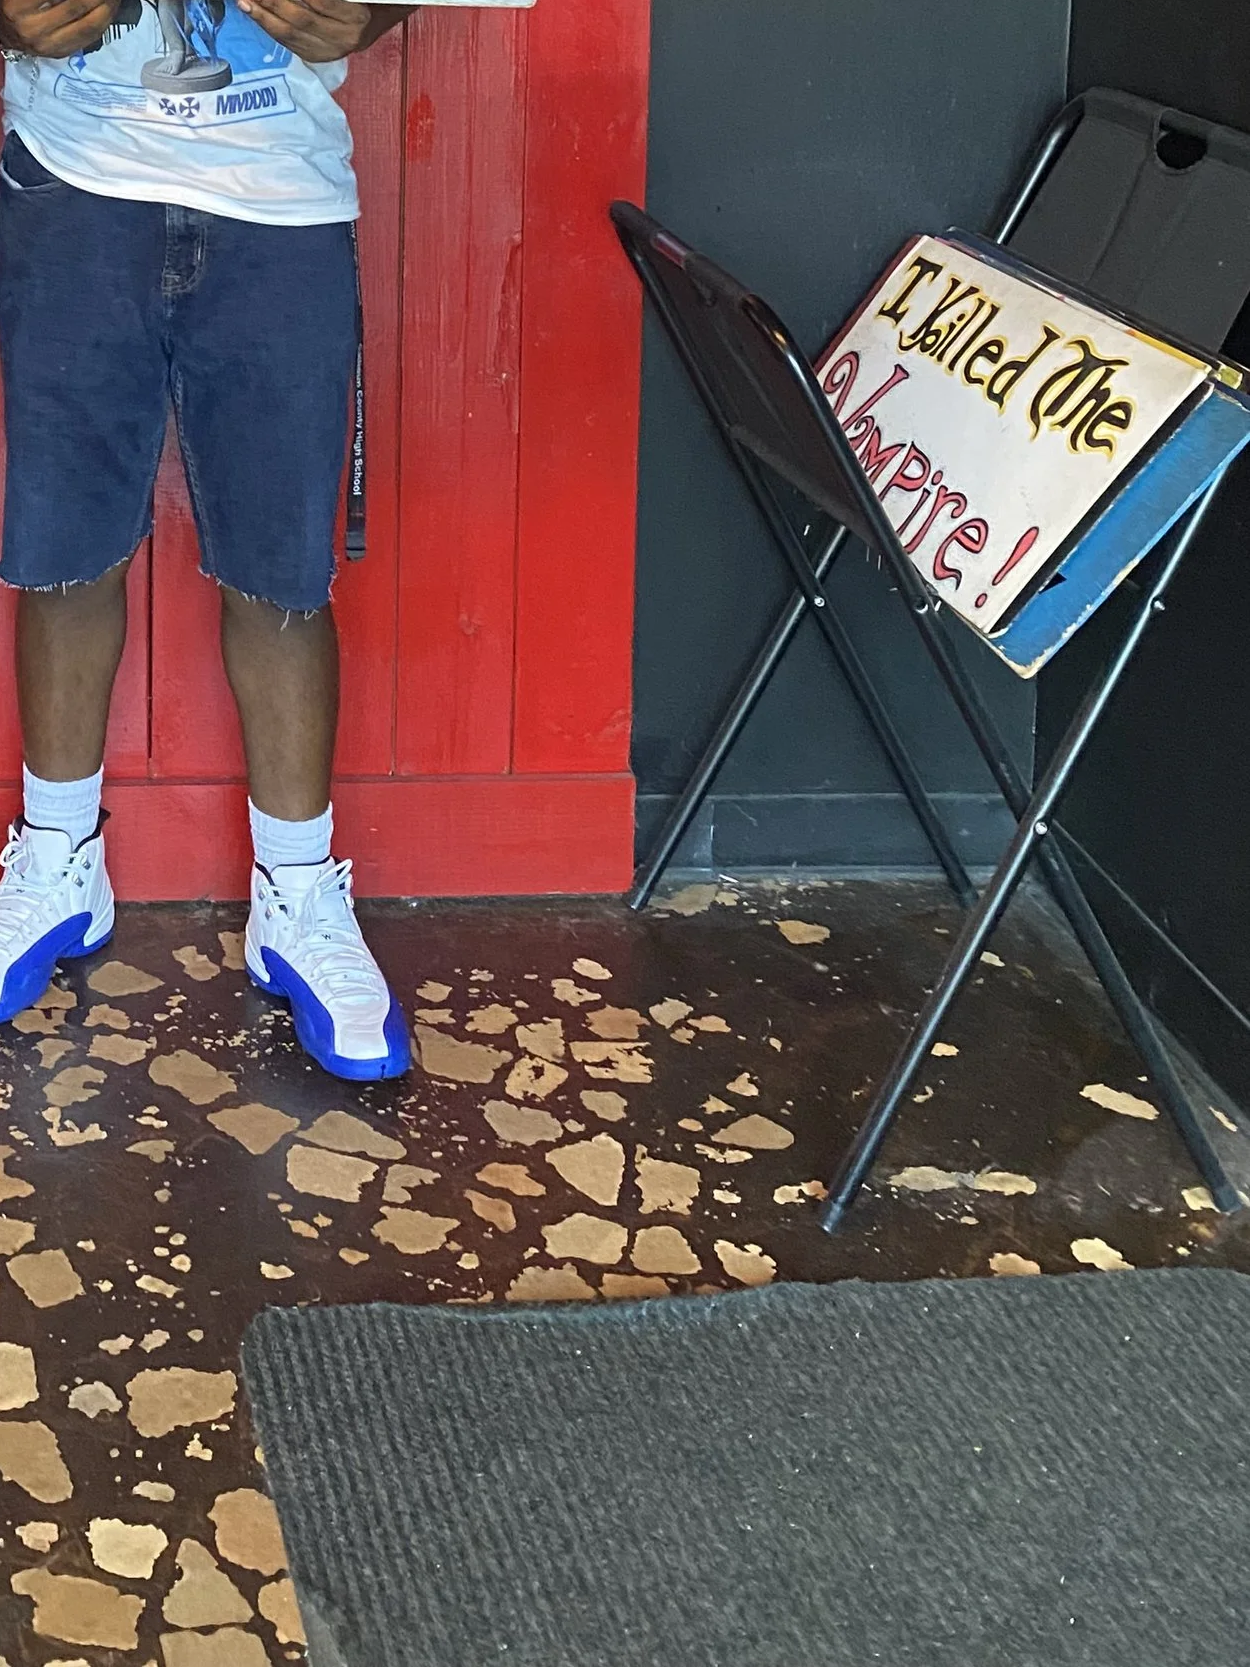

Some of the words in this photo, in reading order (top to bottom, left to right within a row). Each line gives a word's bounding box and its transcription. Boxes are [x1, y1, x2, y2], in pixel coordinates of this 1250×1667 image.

[877, 255, 943, 327] I
[1027, 338, 1138, 463] The
[353, 431, 363, 456] High
[352, 459, 363, 495] School
